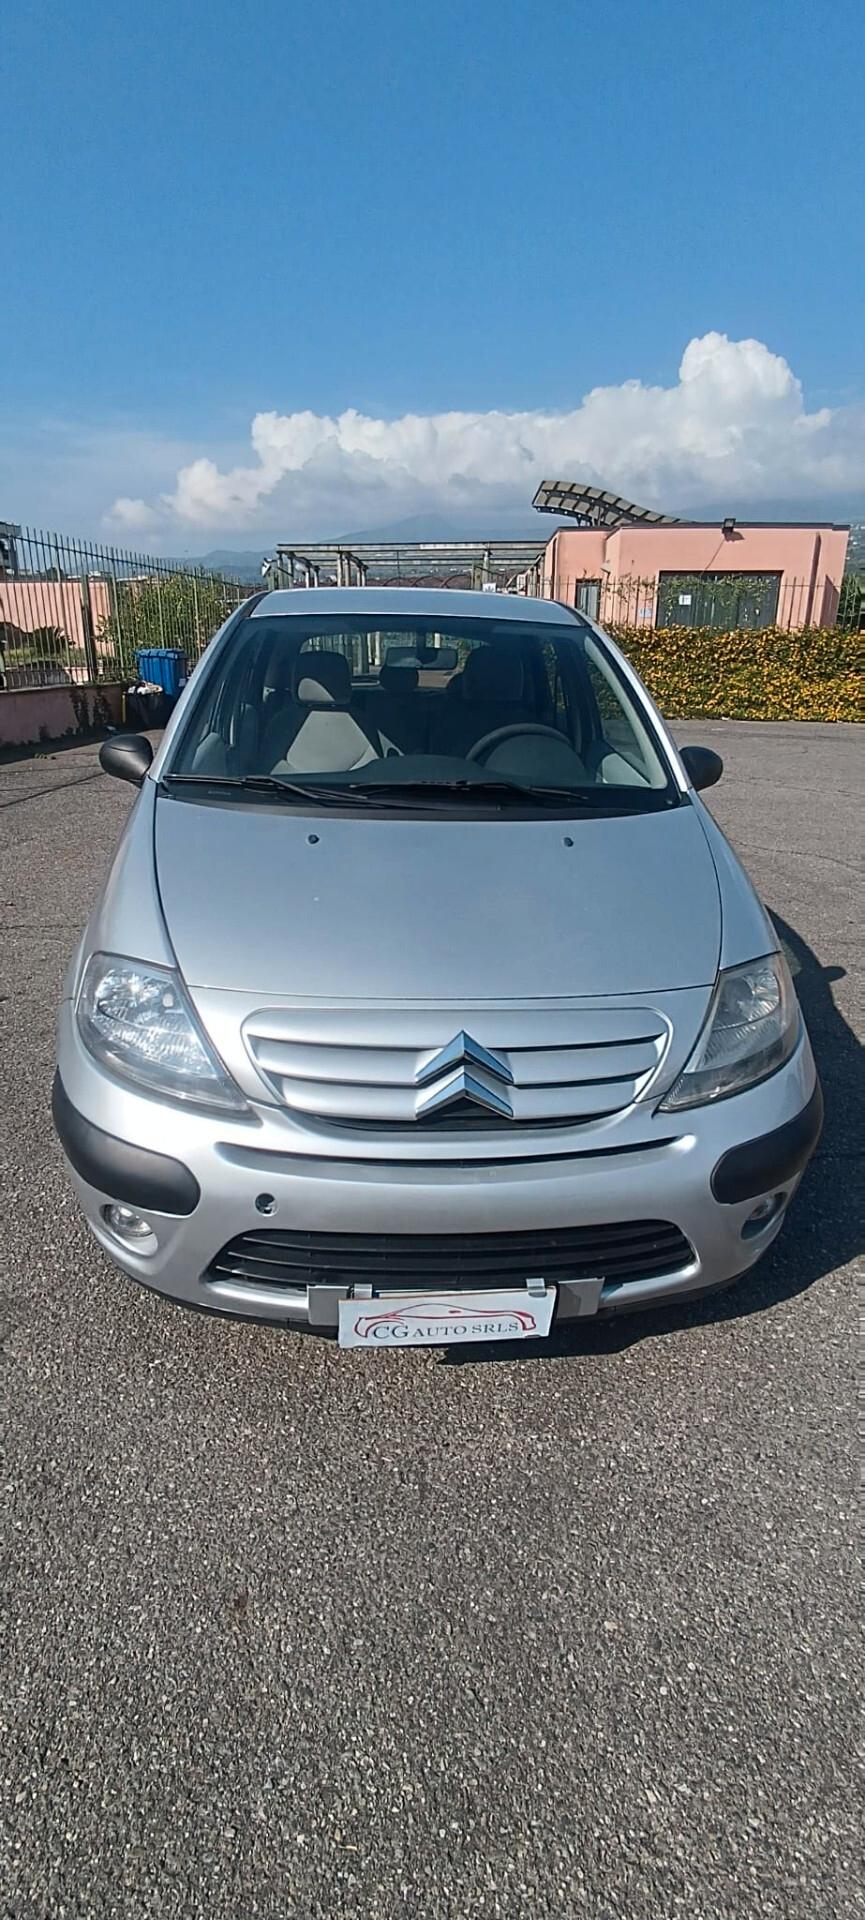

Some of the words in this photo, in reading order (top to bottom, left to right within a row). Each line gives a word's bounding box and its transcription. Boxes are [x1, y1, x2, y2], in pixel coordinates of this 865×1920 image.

[373, 1323, 409, 1339] CG
[412, 1325, 467, 1338] AUTO
[472, 1321, 519, 1333] SRLS
